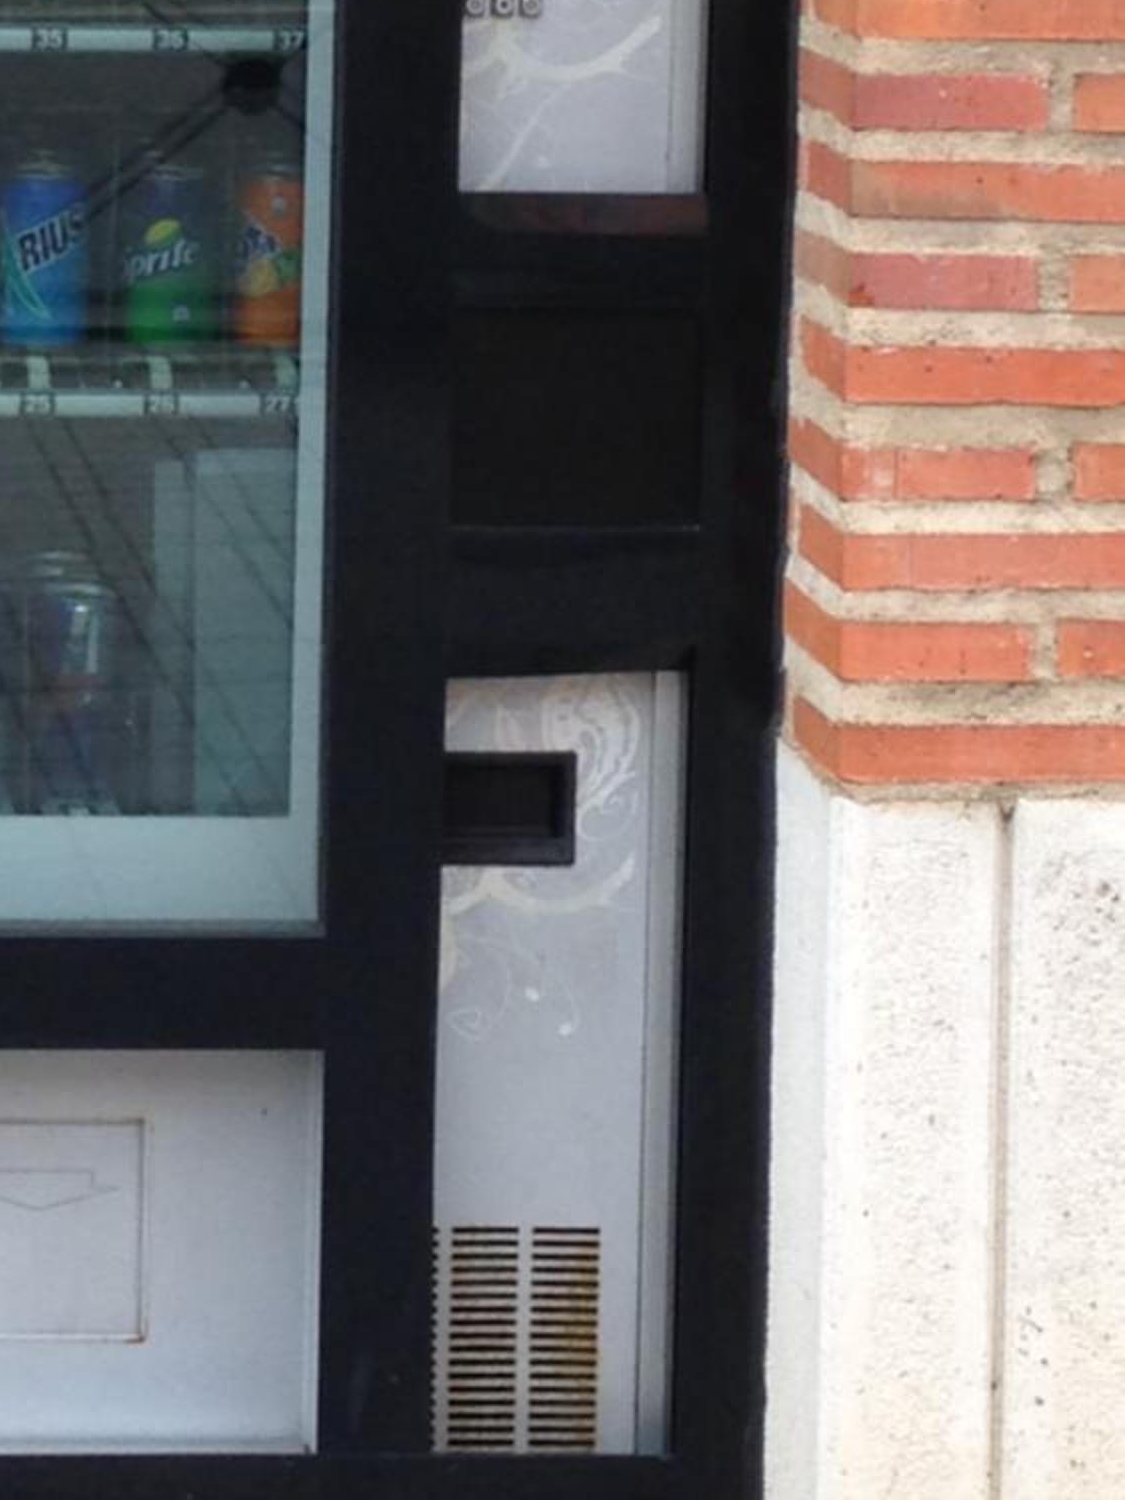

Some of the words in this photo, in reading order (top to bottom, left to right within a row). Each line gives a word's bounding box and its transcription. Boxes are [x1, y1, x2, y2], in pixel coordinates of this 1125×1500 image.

[35, 29, 64, 49] 35
[277, 30, 305, 50] 37
[121, 236, 201, 283] prite
